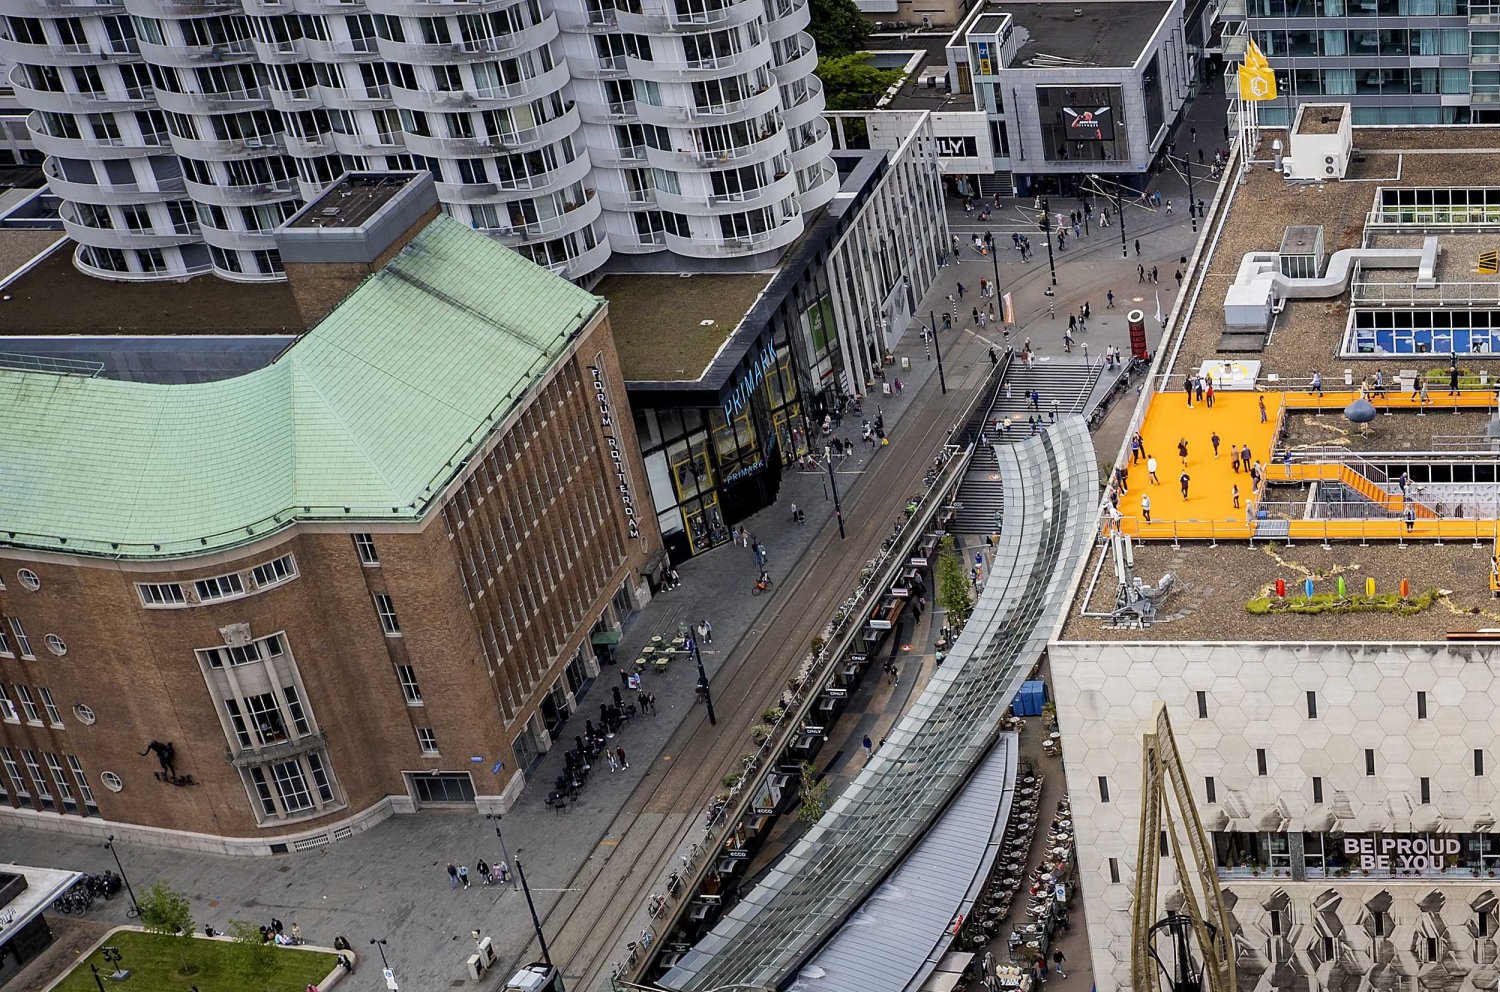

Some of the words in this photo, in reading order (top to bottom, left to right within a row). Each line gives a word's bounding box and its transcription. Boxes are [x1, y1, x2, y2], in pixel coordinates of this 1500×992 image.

[724, 337, 778, 427] PRIMARK
[591, 368, 612, 426] FORUM
[608, 437, 640, 538] ROTTERDAM
[726, 459, 764, 484] PRIMARK
[1343, 838, 1374, 854] BE
[1381, 838, 1461, 854] PROUD
[1360, 854, 1390, 870] BE
[1399, 855, 1444, 870] YOU
